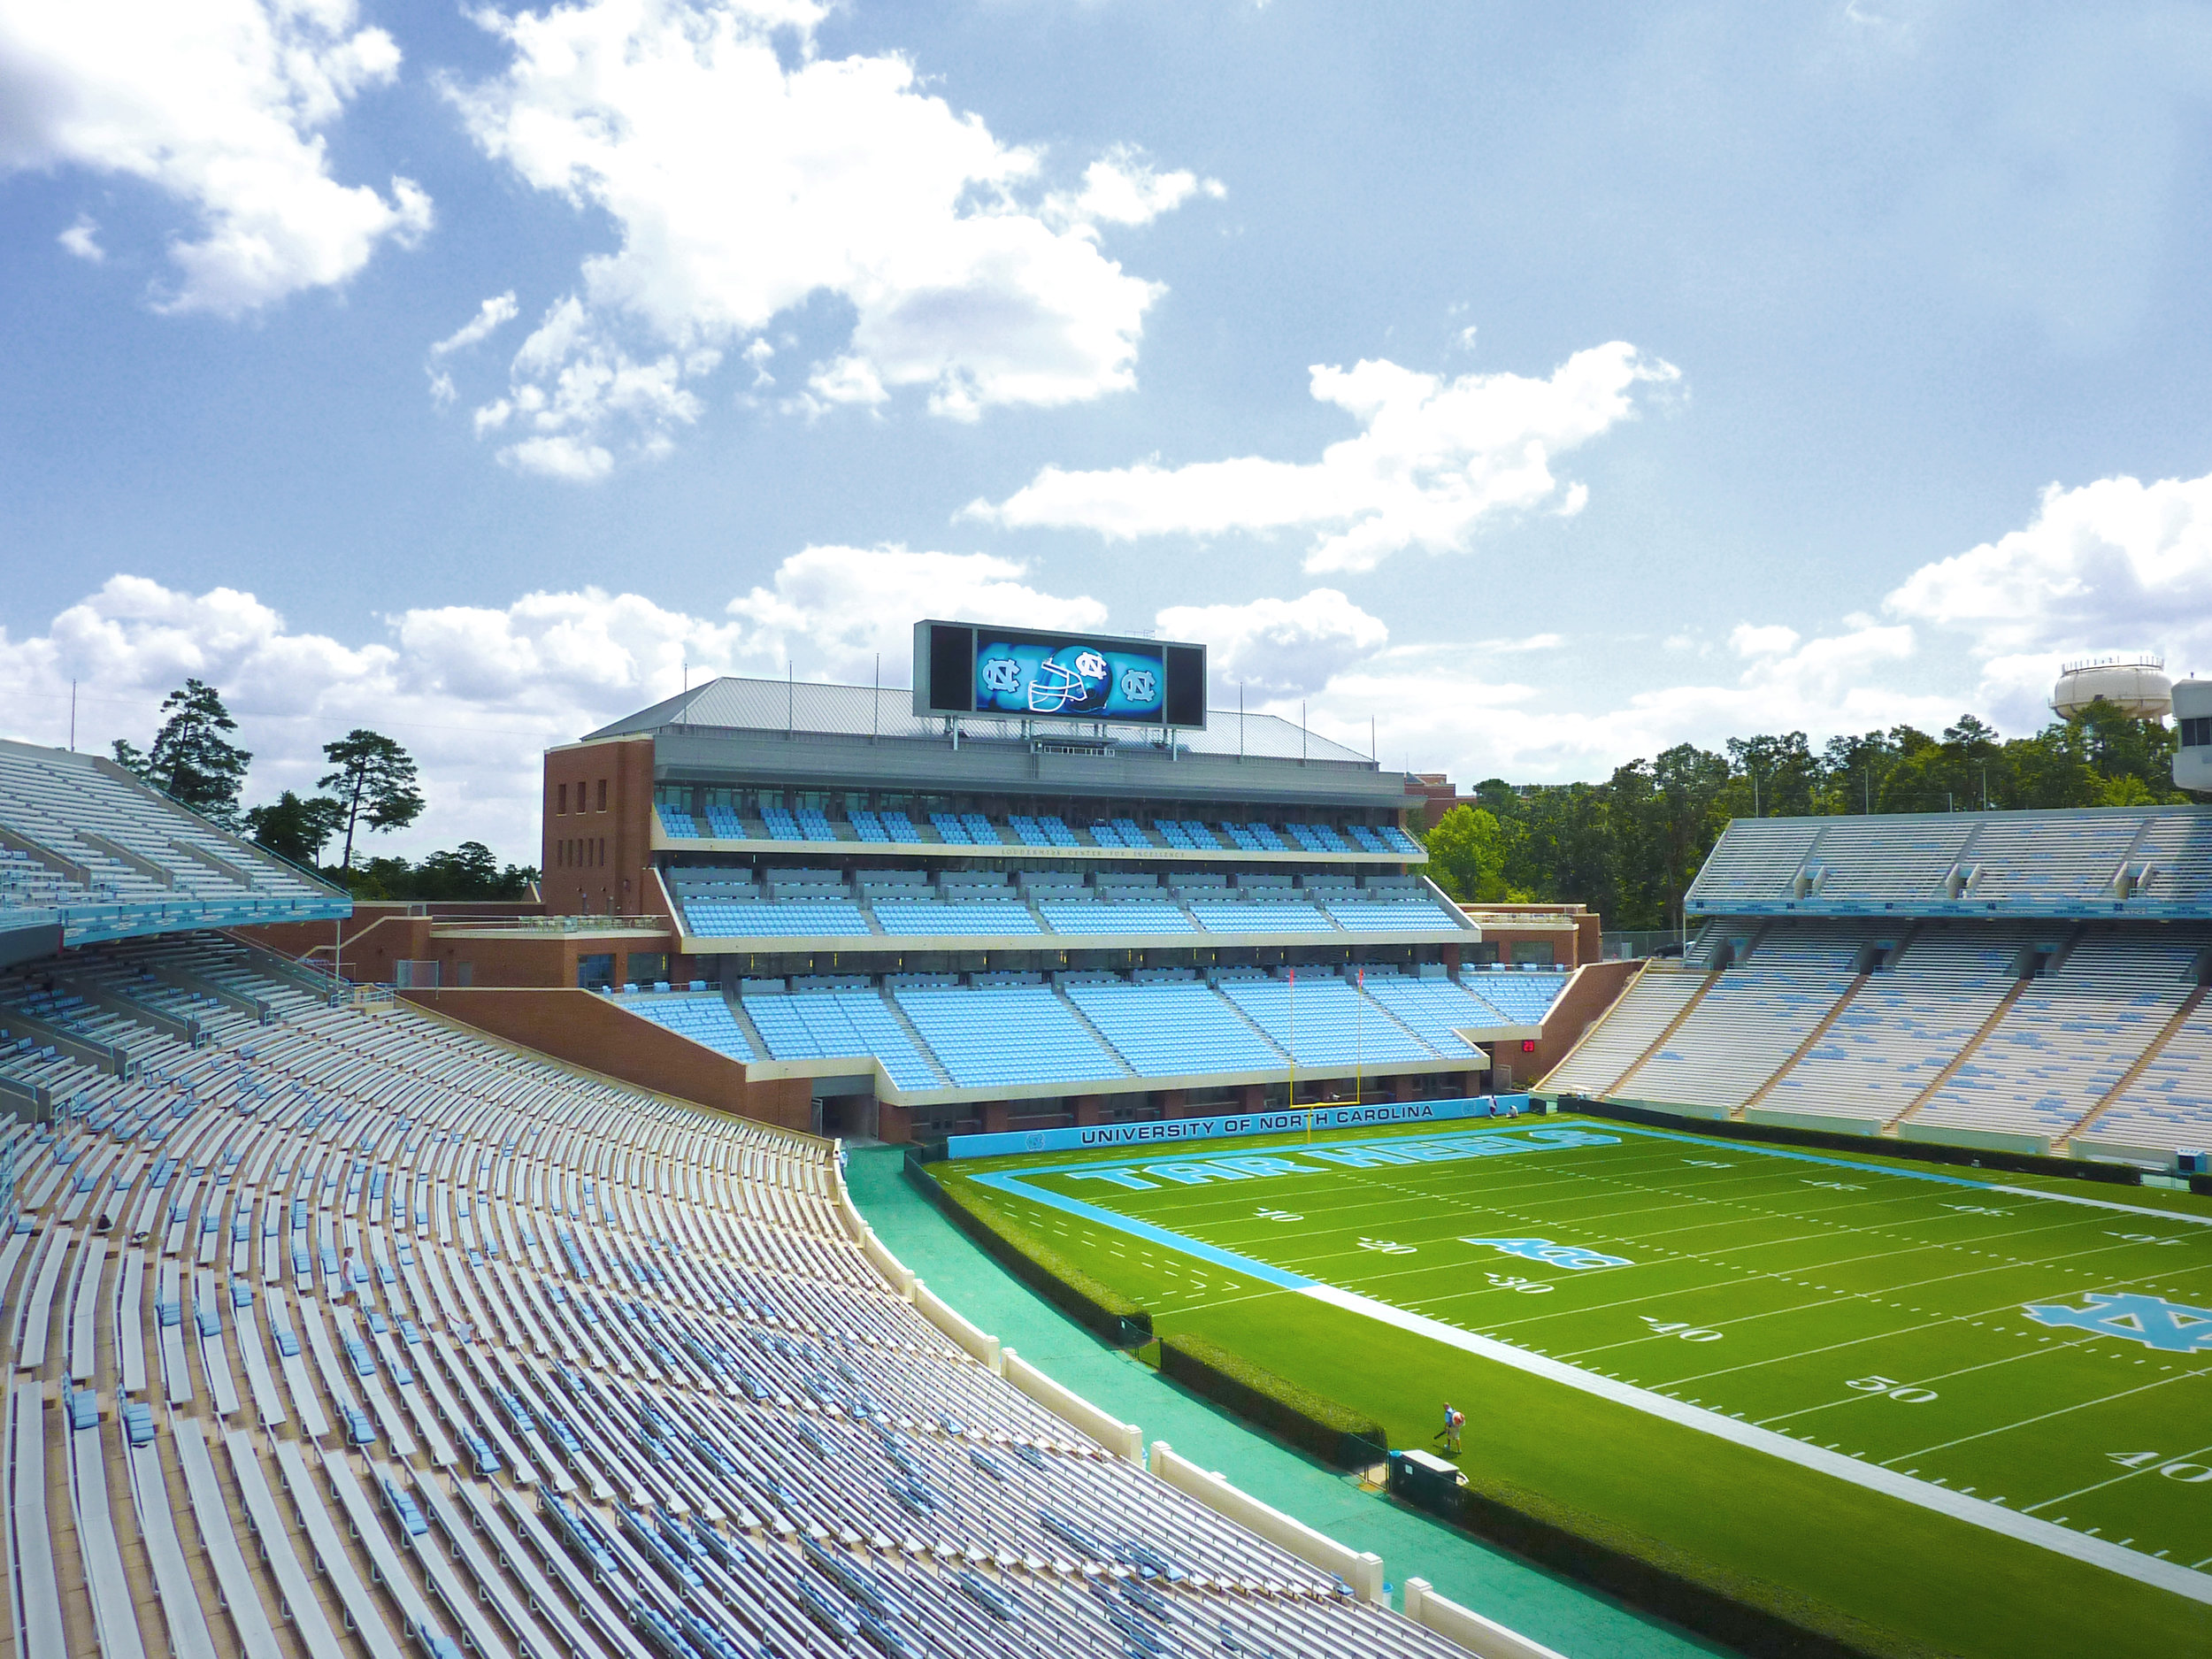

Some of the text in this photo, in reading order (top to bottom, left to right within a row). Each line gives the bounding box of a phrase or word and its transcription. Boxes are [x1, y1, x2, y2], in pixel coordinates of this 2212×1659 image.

[1082, 1105, 1433, 1143] UNIVERSITY OF NORTH CAROLINA
[1064, 1129, 1622, 1190] TAR HEELS
[1253, 1209, 1304, 1222] 10
[1356, 1239, 1417, 1255] 20
[1457, 1238, 1636, 1271] ACC
[1488, 1276, 1555, 1294] 30
[1647, 1323, 1724, 1342] 40
[1845, 1375, 1939, 1403] 50
[2104, 1451, 2212, 1483] 40
